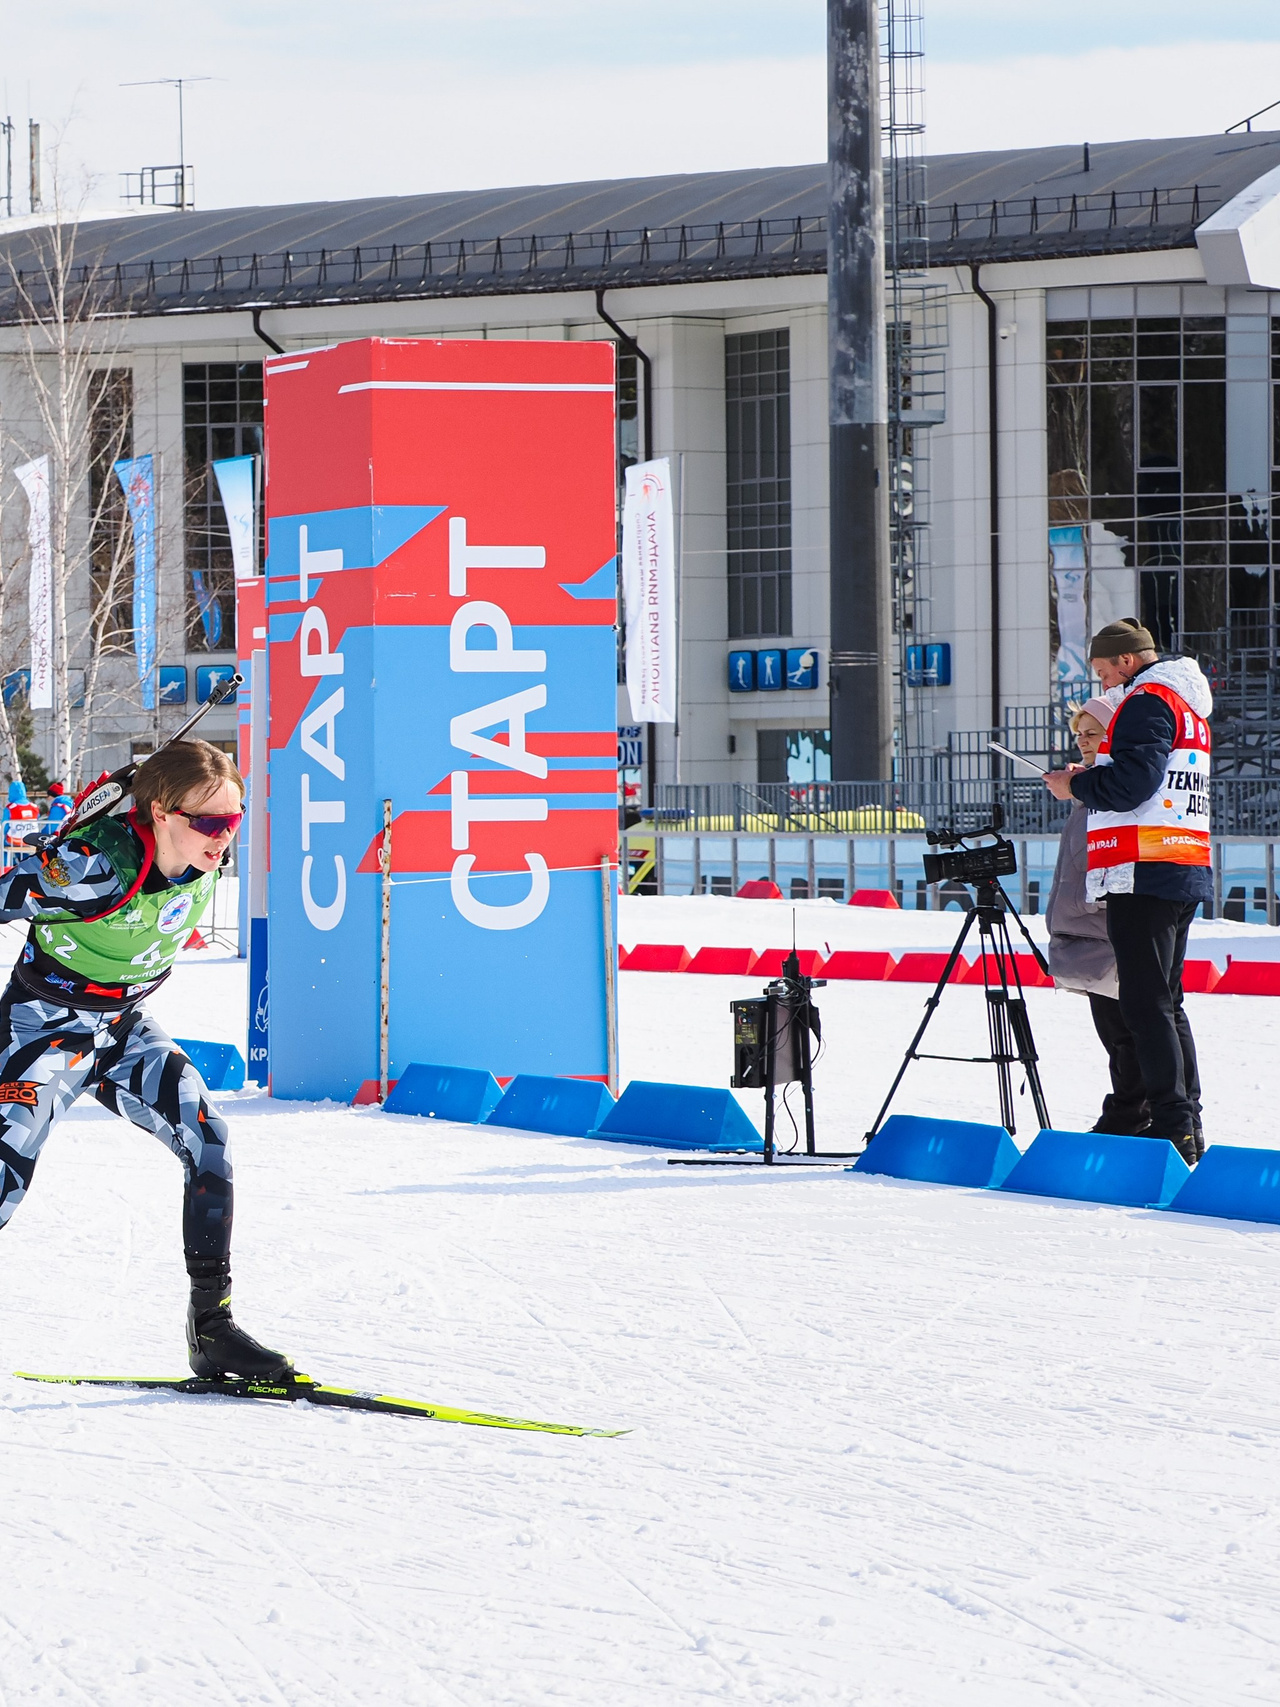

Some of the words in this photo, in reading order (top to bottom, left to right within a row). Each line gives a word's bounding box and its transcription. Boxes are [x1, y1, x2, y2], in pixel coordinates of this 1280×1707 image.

[299, 524, 347, 932] СТАРТ
[449, 516, 551, 931] СТАРТ
[81, 788, 112, 815] LARSEN
[130, 926, 194, 970] 42
[247, 1384, 288, 1395] FISCHER
